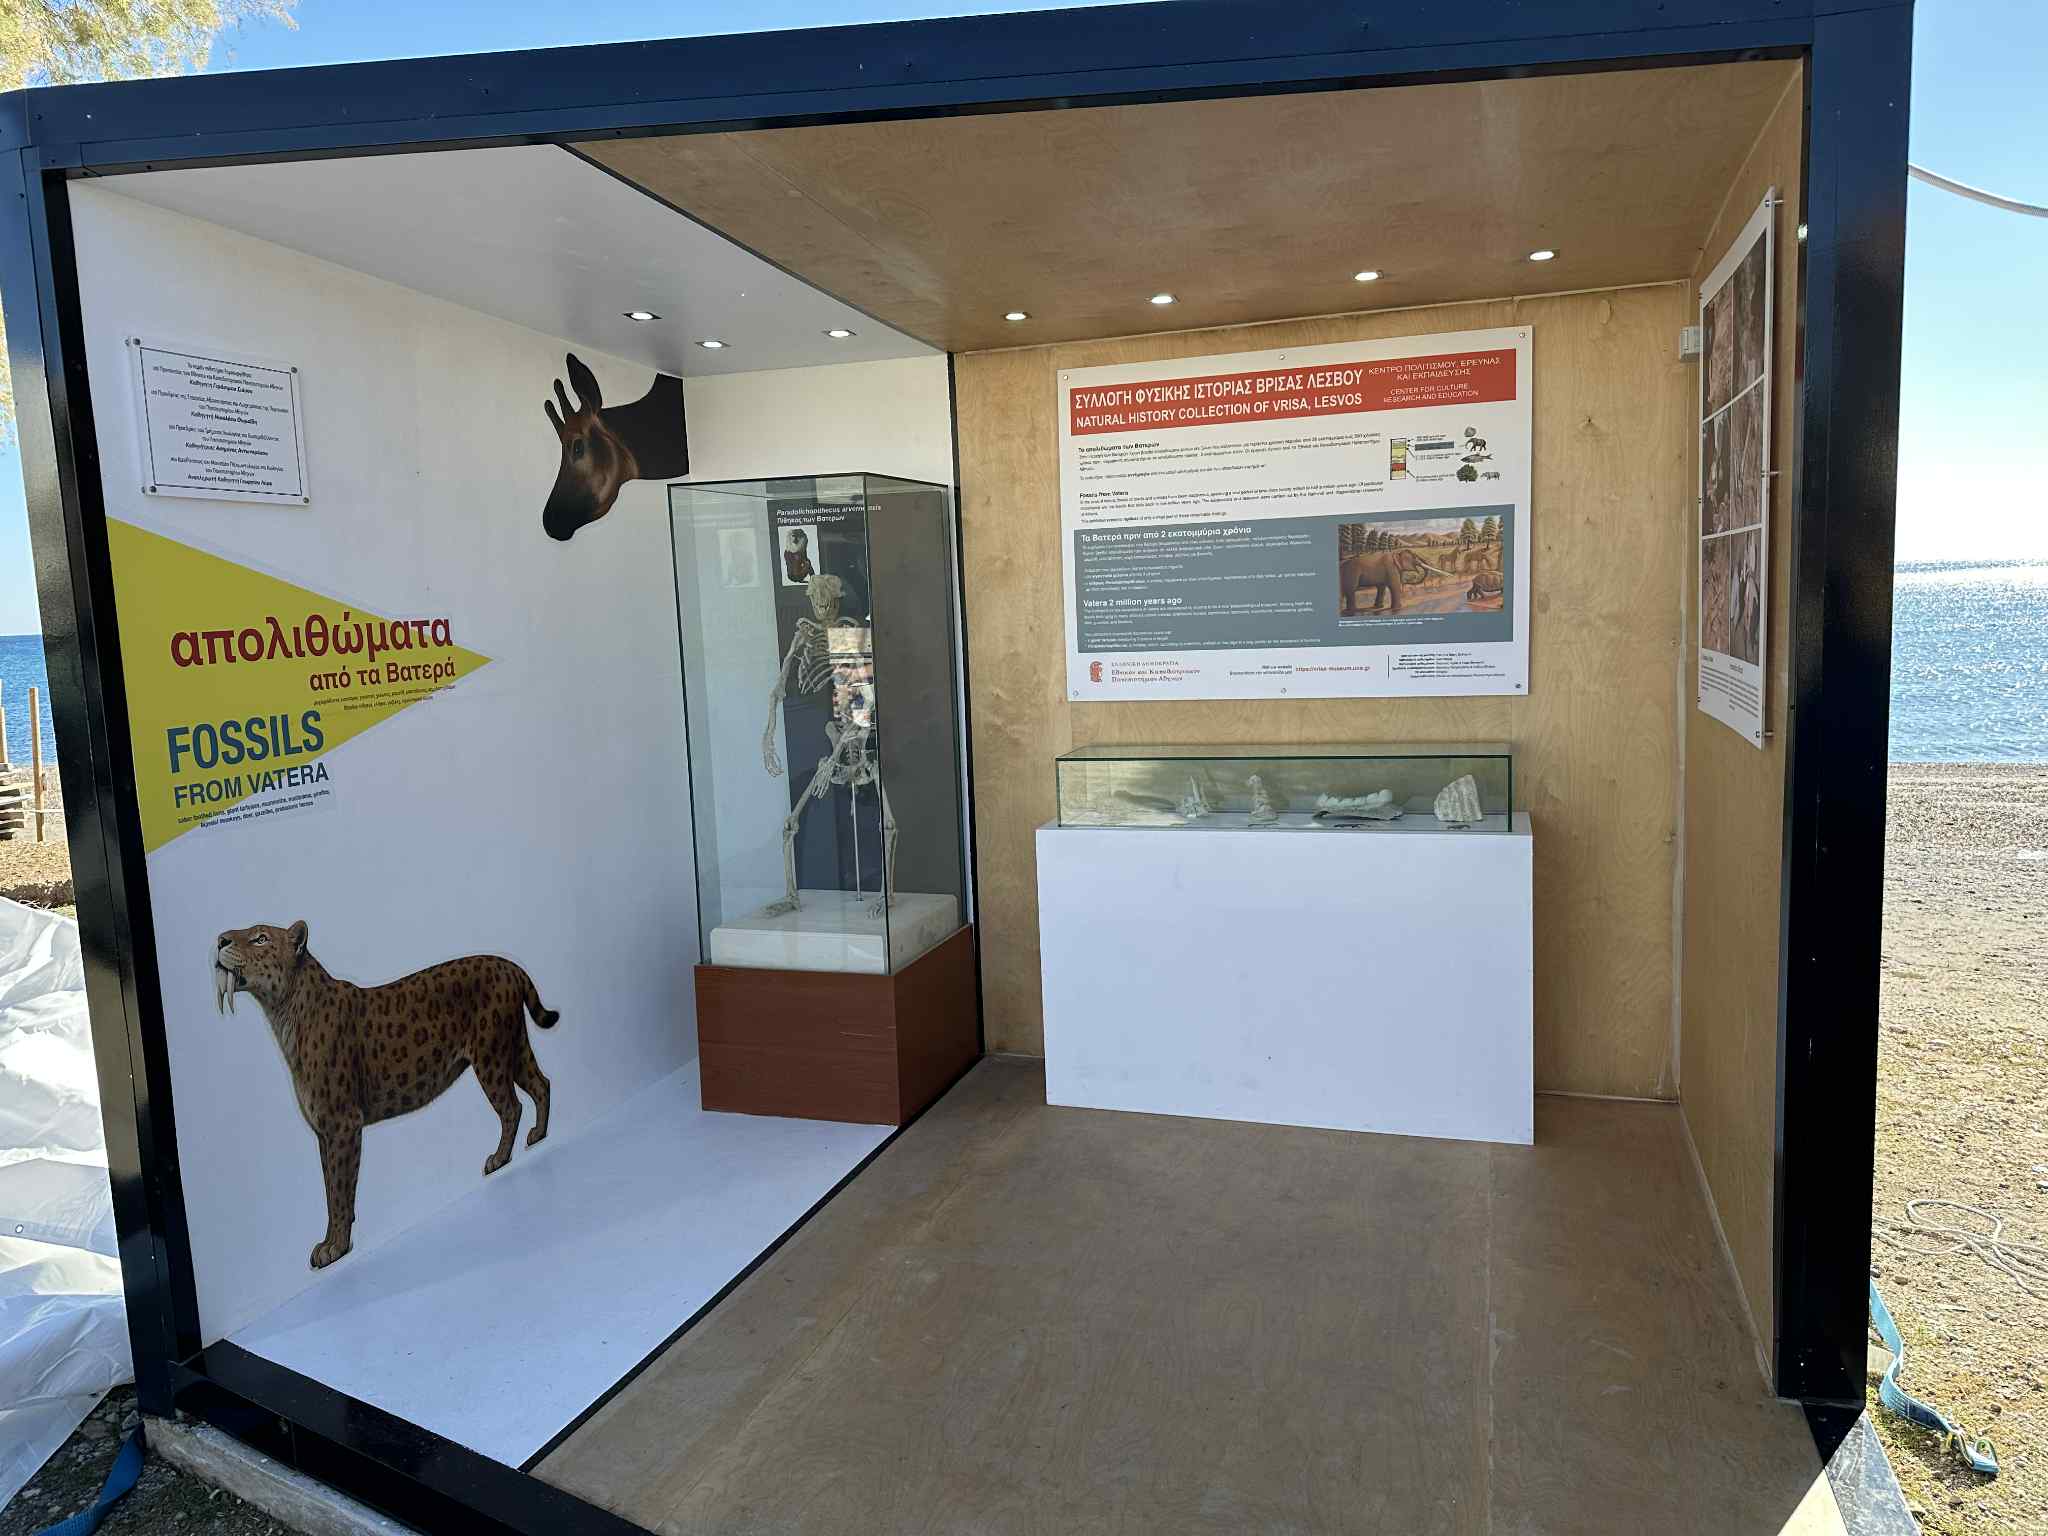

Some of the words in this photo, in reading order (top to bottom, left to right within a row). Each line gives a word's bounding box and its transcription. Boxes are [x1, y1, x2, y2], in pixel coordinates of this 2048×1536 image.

[1368, 365, 1402, 376] ΚΕΝΤΡΟ
[1460, 357, 1500, 368] ΕΡΕΥΝΑΣ
[1412, 368, 1472, 380] ΕΚΠΑΙΔΕΥΣΗΣ
[1075, 391, 1132, 409] ΣΥΛΛΟΓΗ
[1135, 386, 1191, 404] ΦΥΣΙΚΗΣ
[1194, 379, 1253, 399] ΙΣΤΟΡΙΑΣ
[1256, 376, 1303, 394] ΒΡΙΣΑΣ
[1306, 369, 1363, 389] ΛΕΣΒΟΥ
[1384, 393, 1422, 403] RESEARCH
[1423, 392, 1437, 400] AND
[1438, 390, 1479, 399] EDUCATION
[1390, 387, 1418, 396] CENTER
[1420, 385, 1435, 393] FOR
[1076, 412, 1127, 428] NATURAL
[1128, 408, 1176, 424] HISTORY
[1178, 402, 1251, 420] COLLECTION
[1253, 401, 1269, 413] OF
[1272, 396, 1311, 411] VRISA,
[1314, 392, 1363, 408] LESVOS
[1081, 534, 1091, 543] Τα
[1092, 533, 1122, 542] Βατερά
[1123, 532, 1141, 542] πριν
[1143, 530, 1159, 540] από
[1160, 530, 1166, 538] 2
[1167, 527, 1221, 539] εκατομμύρια
[1222, 526, 1252, 537] χρόνια
[1083, 599, 1107, 608] Vatera
[1115, 598, 1141, 607] million
[1143, 599, 1165, 608] years
[1167, 598, 1182, 607] ago
[171, 611, 453, 668] απολιθώματα
[310, 665, 350, 691] από
[357, 668, 381, 686] τα
[386, 656, 455, 683] Βατερά
[167, 710, 324, 774] FOSSILS
[174, 776, 242, 808] FROM
[247, 762, 329, 794] VATERA
